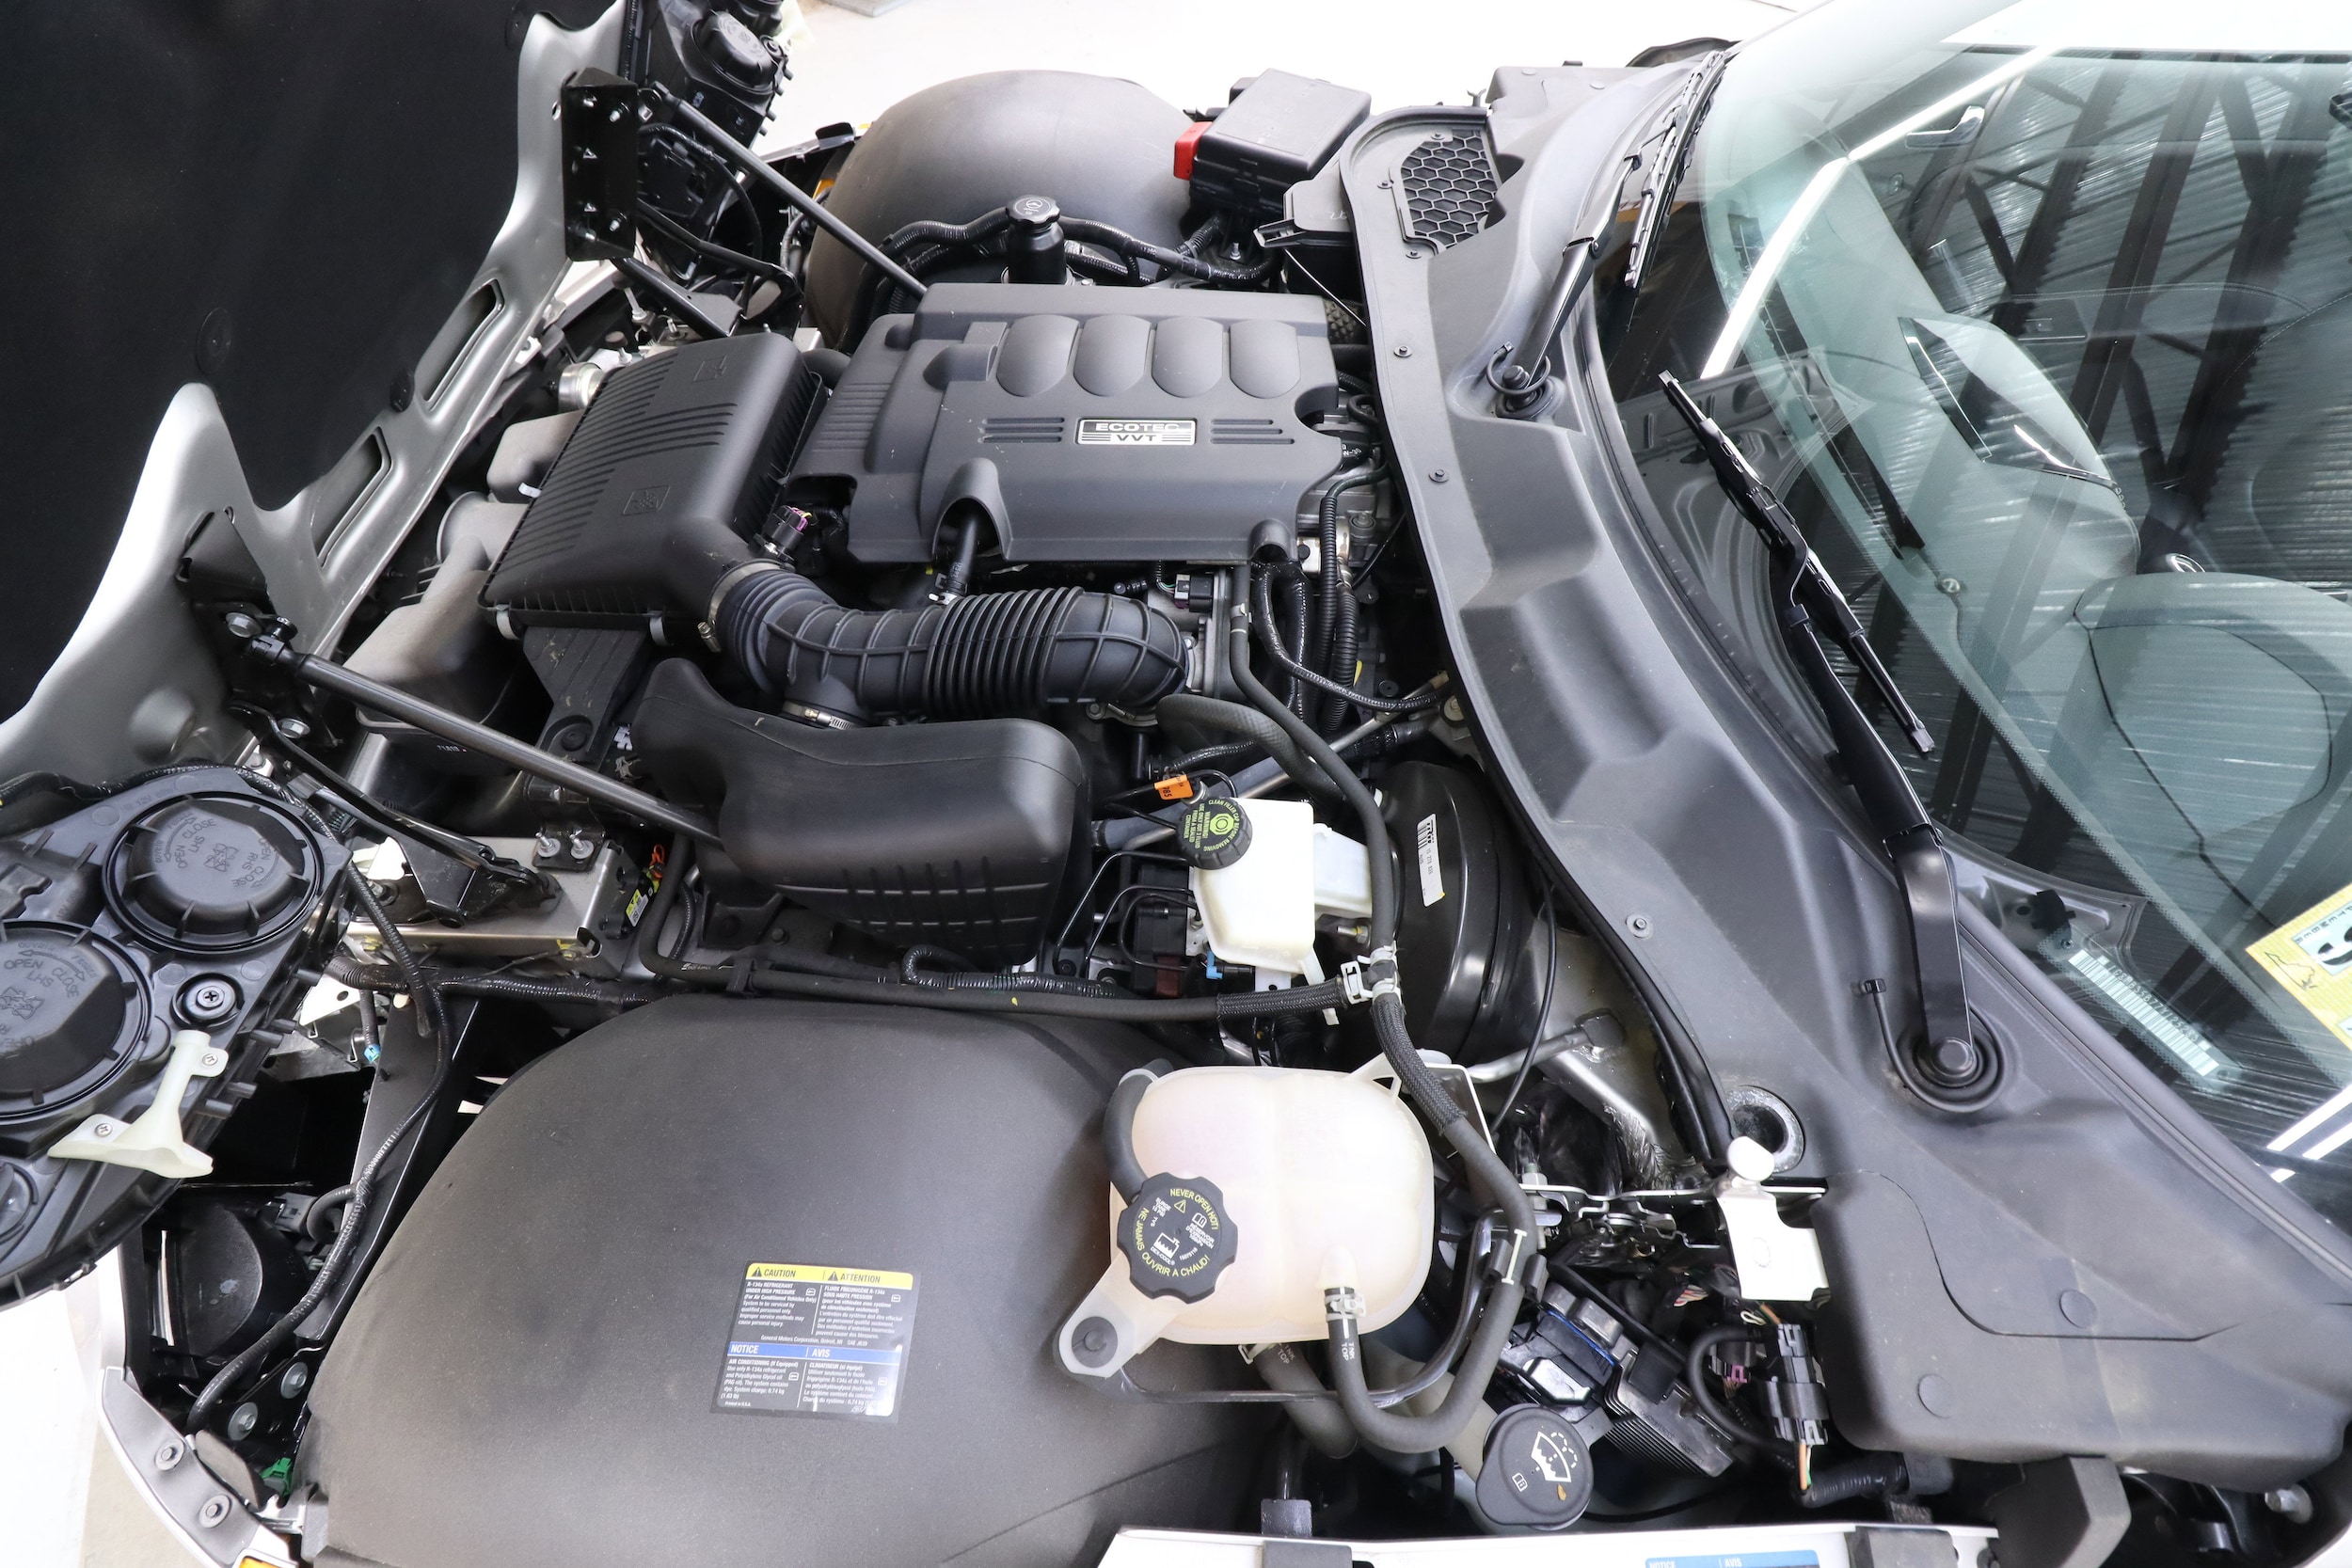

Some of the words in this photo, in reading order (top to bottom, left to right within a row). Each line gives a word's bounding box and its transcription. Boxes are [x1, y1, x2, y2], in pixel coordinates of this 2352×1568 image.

[1095, 423, 1180, 432] ECOTEC
[182, 818, 215, 838] CLOSE
[1228, 823, 1239, 839] BEFORE
[188, 835, 205, 853] LHS
[1203, 838, 1230, 851] REMOVING
[176, 845, 188, 868] OPEN
[242, 852, 259, 871] RHS
[231, 865, 264, 888] CLOSE
[4, 958, 43, 970] OPEN
[26, 971, 55, 987] LHS
[52, 967, 79, 999] CLOSE
[1138, 1208, 1150, 1221] NE
[1170, 1189, 1194, 1199] NEVER
[1195, 1195, 1211, 1212] OPEN
[1207, 1212, 1218, 1229] HOT!
[1136, 1220, 1144, 1251] JAMAIS
[1142, 1252, 1170, 1276] OUVRIR
[1181, 1255, 1210, 1275] CHAUD!
[763, 1268, 796, 1277] CAUTION
[839, 1273, 881, 1283] ATTENTION
[730, 1343, 759, 1354] NOTICE
[811, 1348, 831, 1357] AVIS
[1278, 1348, 1290, 1364] TOP
